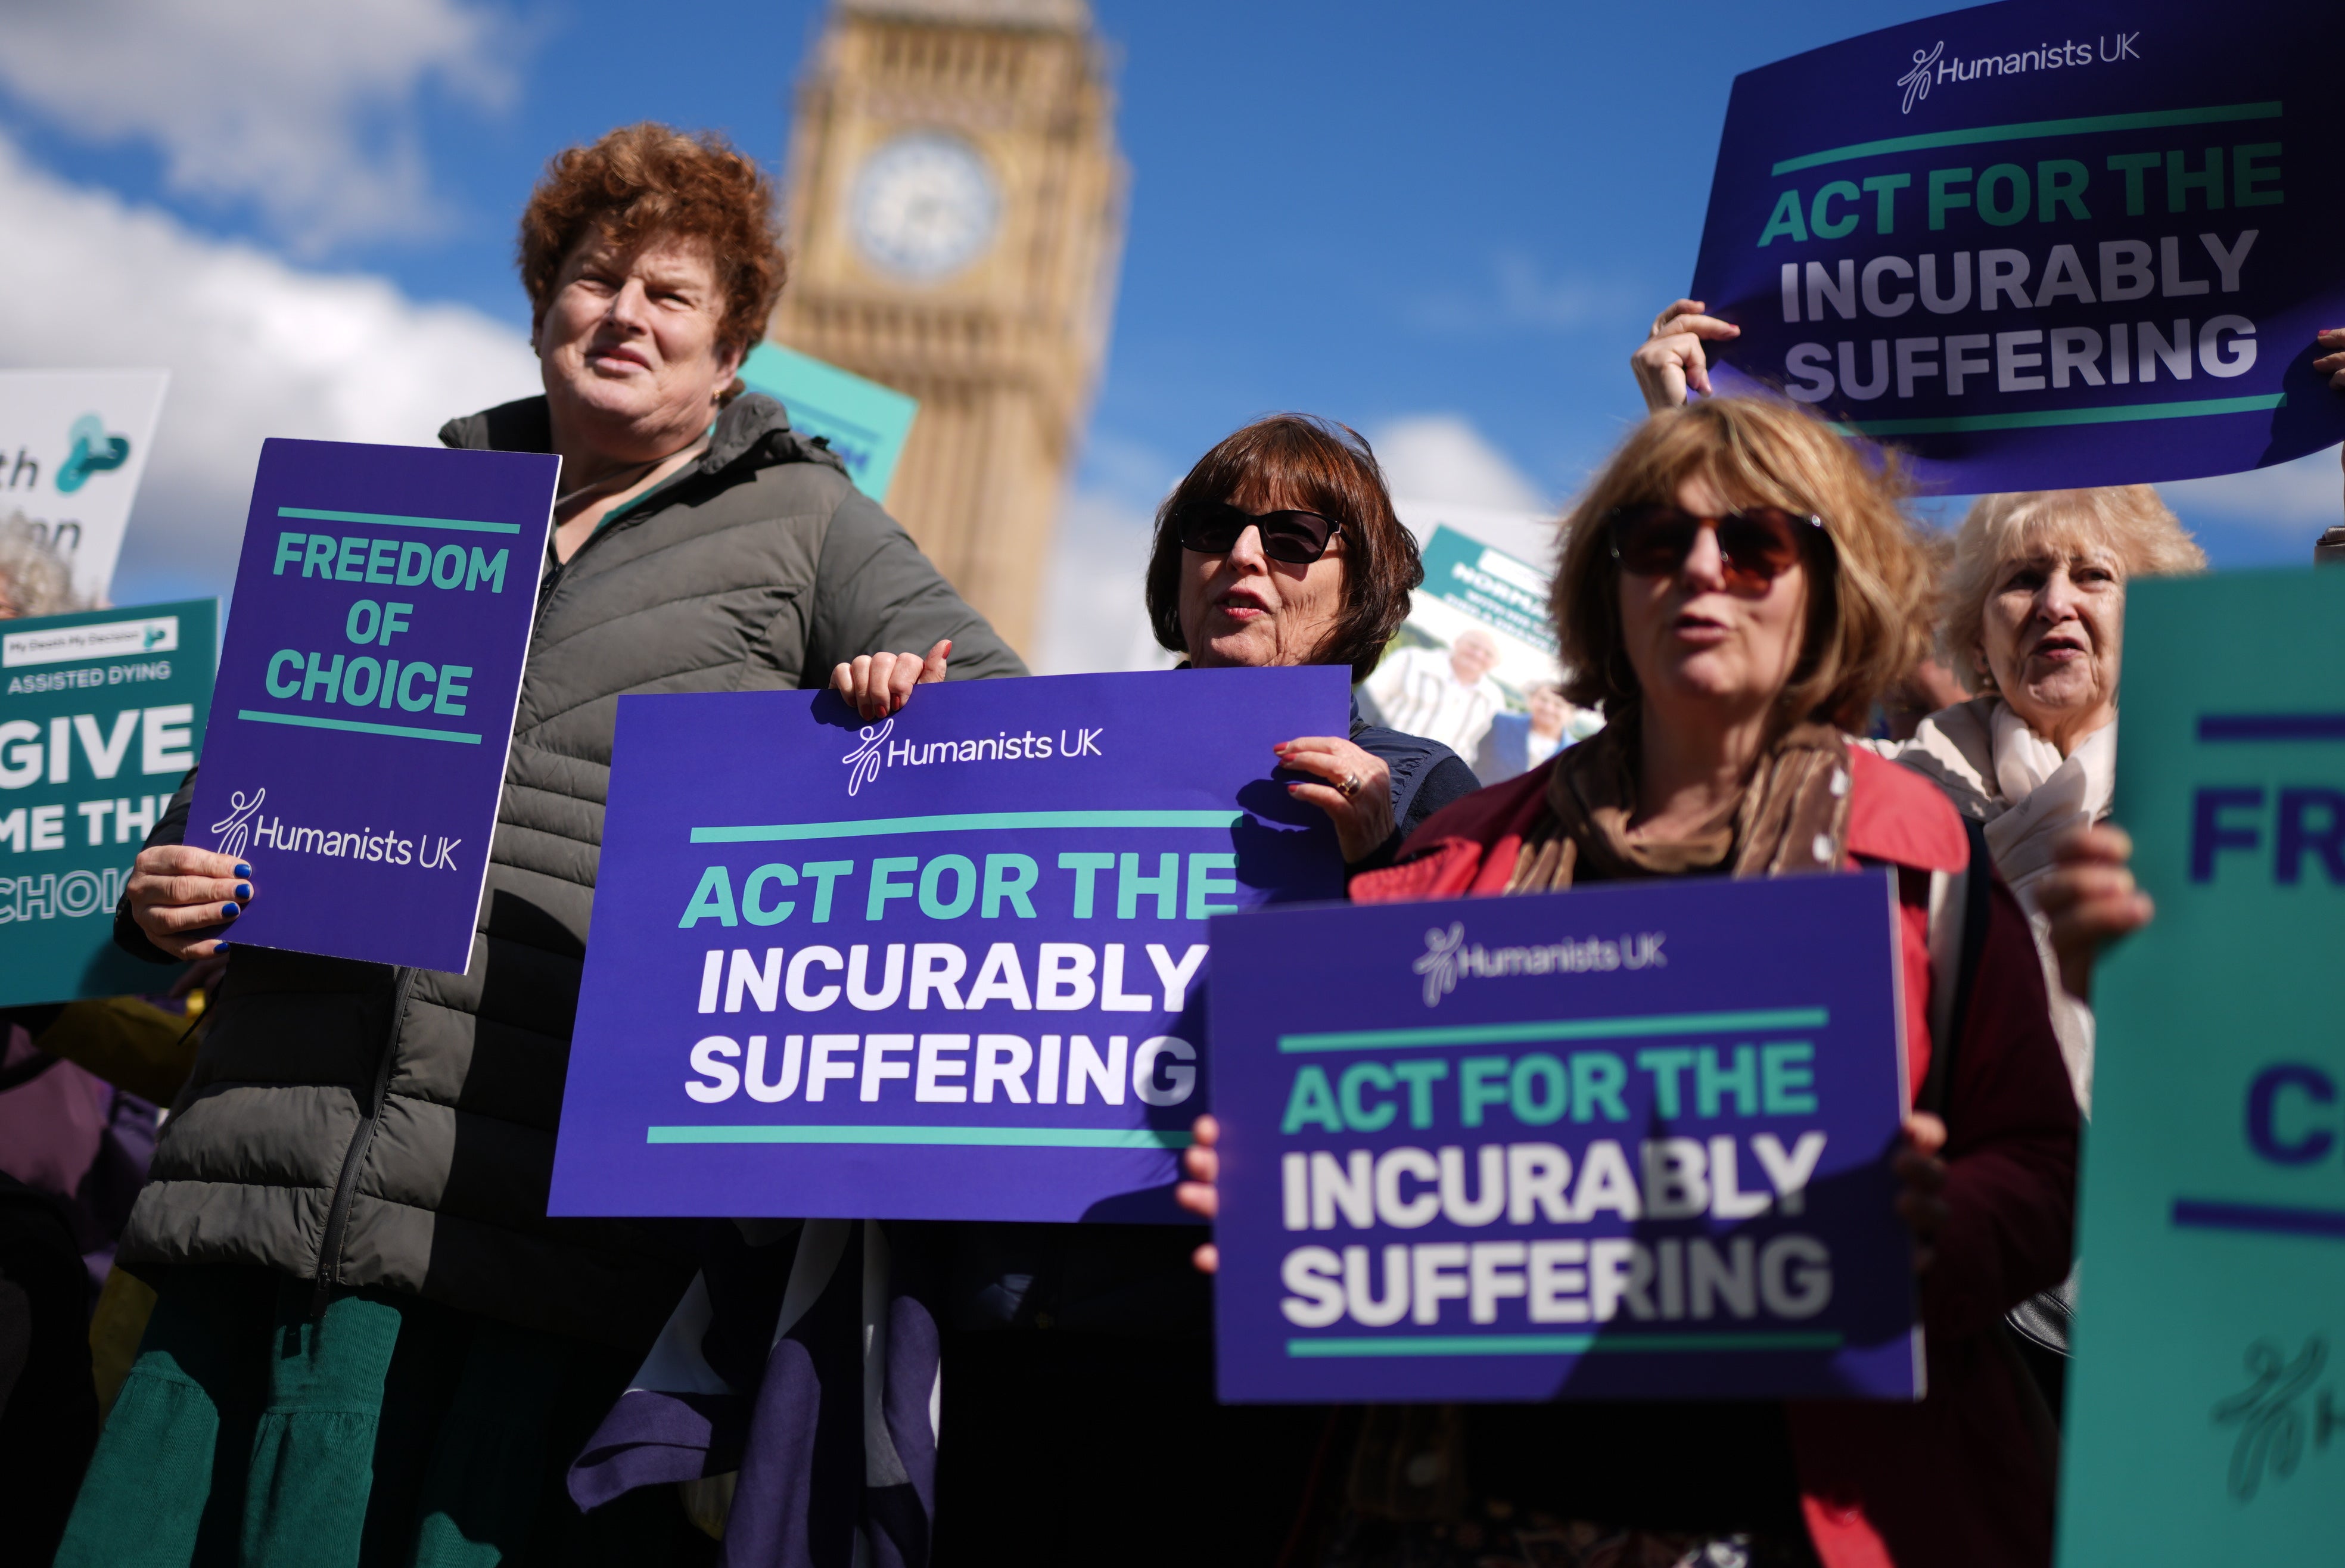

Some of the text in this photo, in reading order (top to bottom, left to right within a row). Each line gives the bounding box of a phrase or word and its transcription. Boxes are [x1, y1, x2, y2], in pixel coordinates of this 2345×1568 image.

[1937, 31, 2141, 85] Humanists UK
[1757, 142, 2284, 247] ACT FOR THE
[1781, 229, 2259, 323] INCURABLY
[1784, 314, 2257, 404] SUFFERING
[273, 531, 509, 594] FREEDOM
[346, 599, 413, 646] OF
[7, 660, 172, 695] ASSISTED DYING
[265, 648, 473, 716] CHOICE
[0, 703, 194, 790] GIVE
[887, 727, 1103, 767] Humanists UK
[254, 814, 462, 871] Humanists UK
[0, 866, 135, 925] CHOI
[677, 852, 1240, 929] ACT FOR THE
[698, 942, 1210, 1014] INCURABLY
[1456, 930, 1668, 979] Humanists UK
[685, 1033, 1197, 1107] SUFFERING
[1280, 1040, 1818, 1135] ACT FOR THE
[1282, 1130, 1828, 1231] INCURABLY
[1279, 1233, 1834, 1329] SUFFERING
